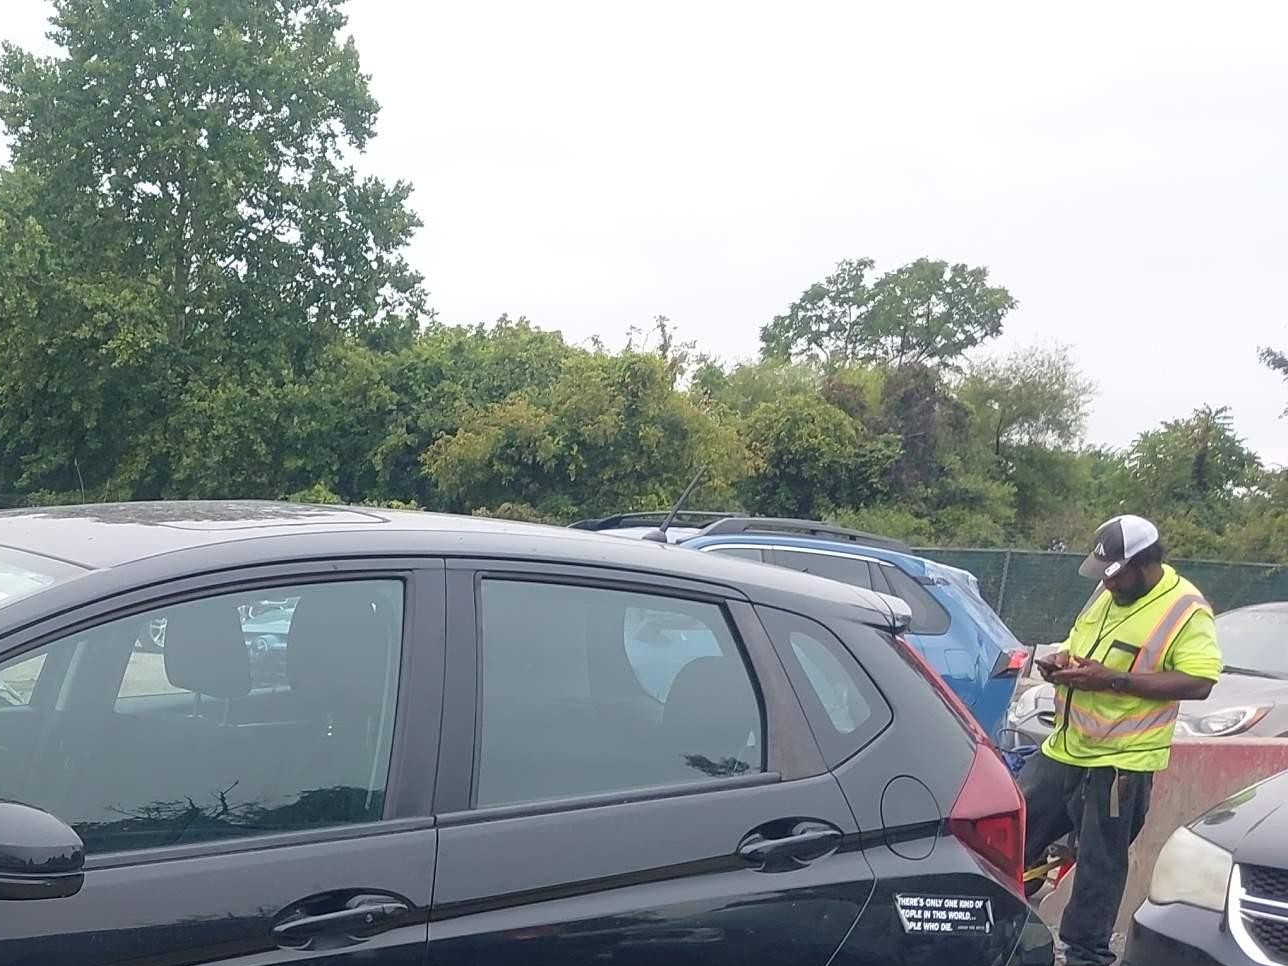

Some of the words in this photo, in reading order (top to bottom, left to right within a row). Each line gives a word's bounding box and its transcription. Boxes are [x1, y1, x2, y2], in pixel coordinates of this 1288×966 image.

[926, 898, 943, 907] ONLY
[944, 899, 958, 908] ONE
[959, 900, 974, 909] KIND
[975, 900, 984, 909] OF
[923, 910, 930, 919] IN
[932, 911, 947, 919] THIS
[923, 922, 940, 931] WHO
